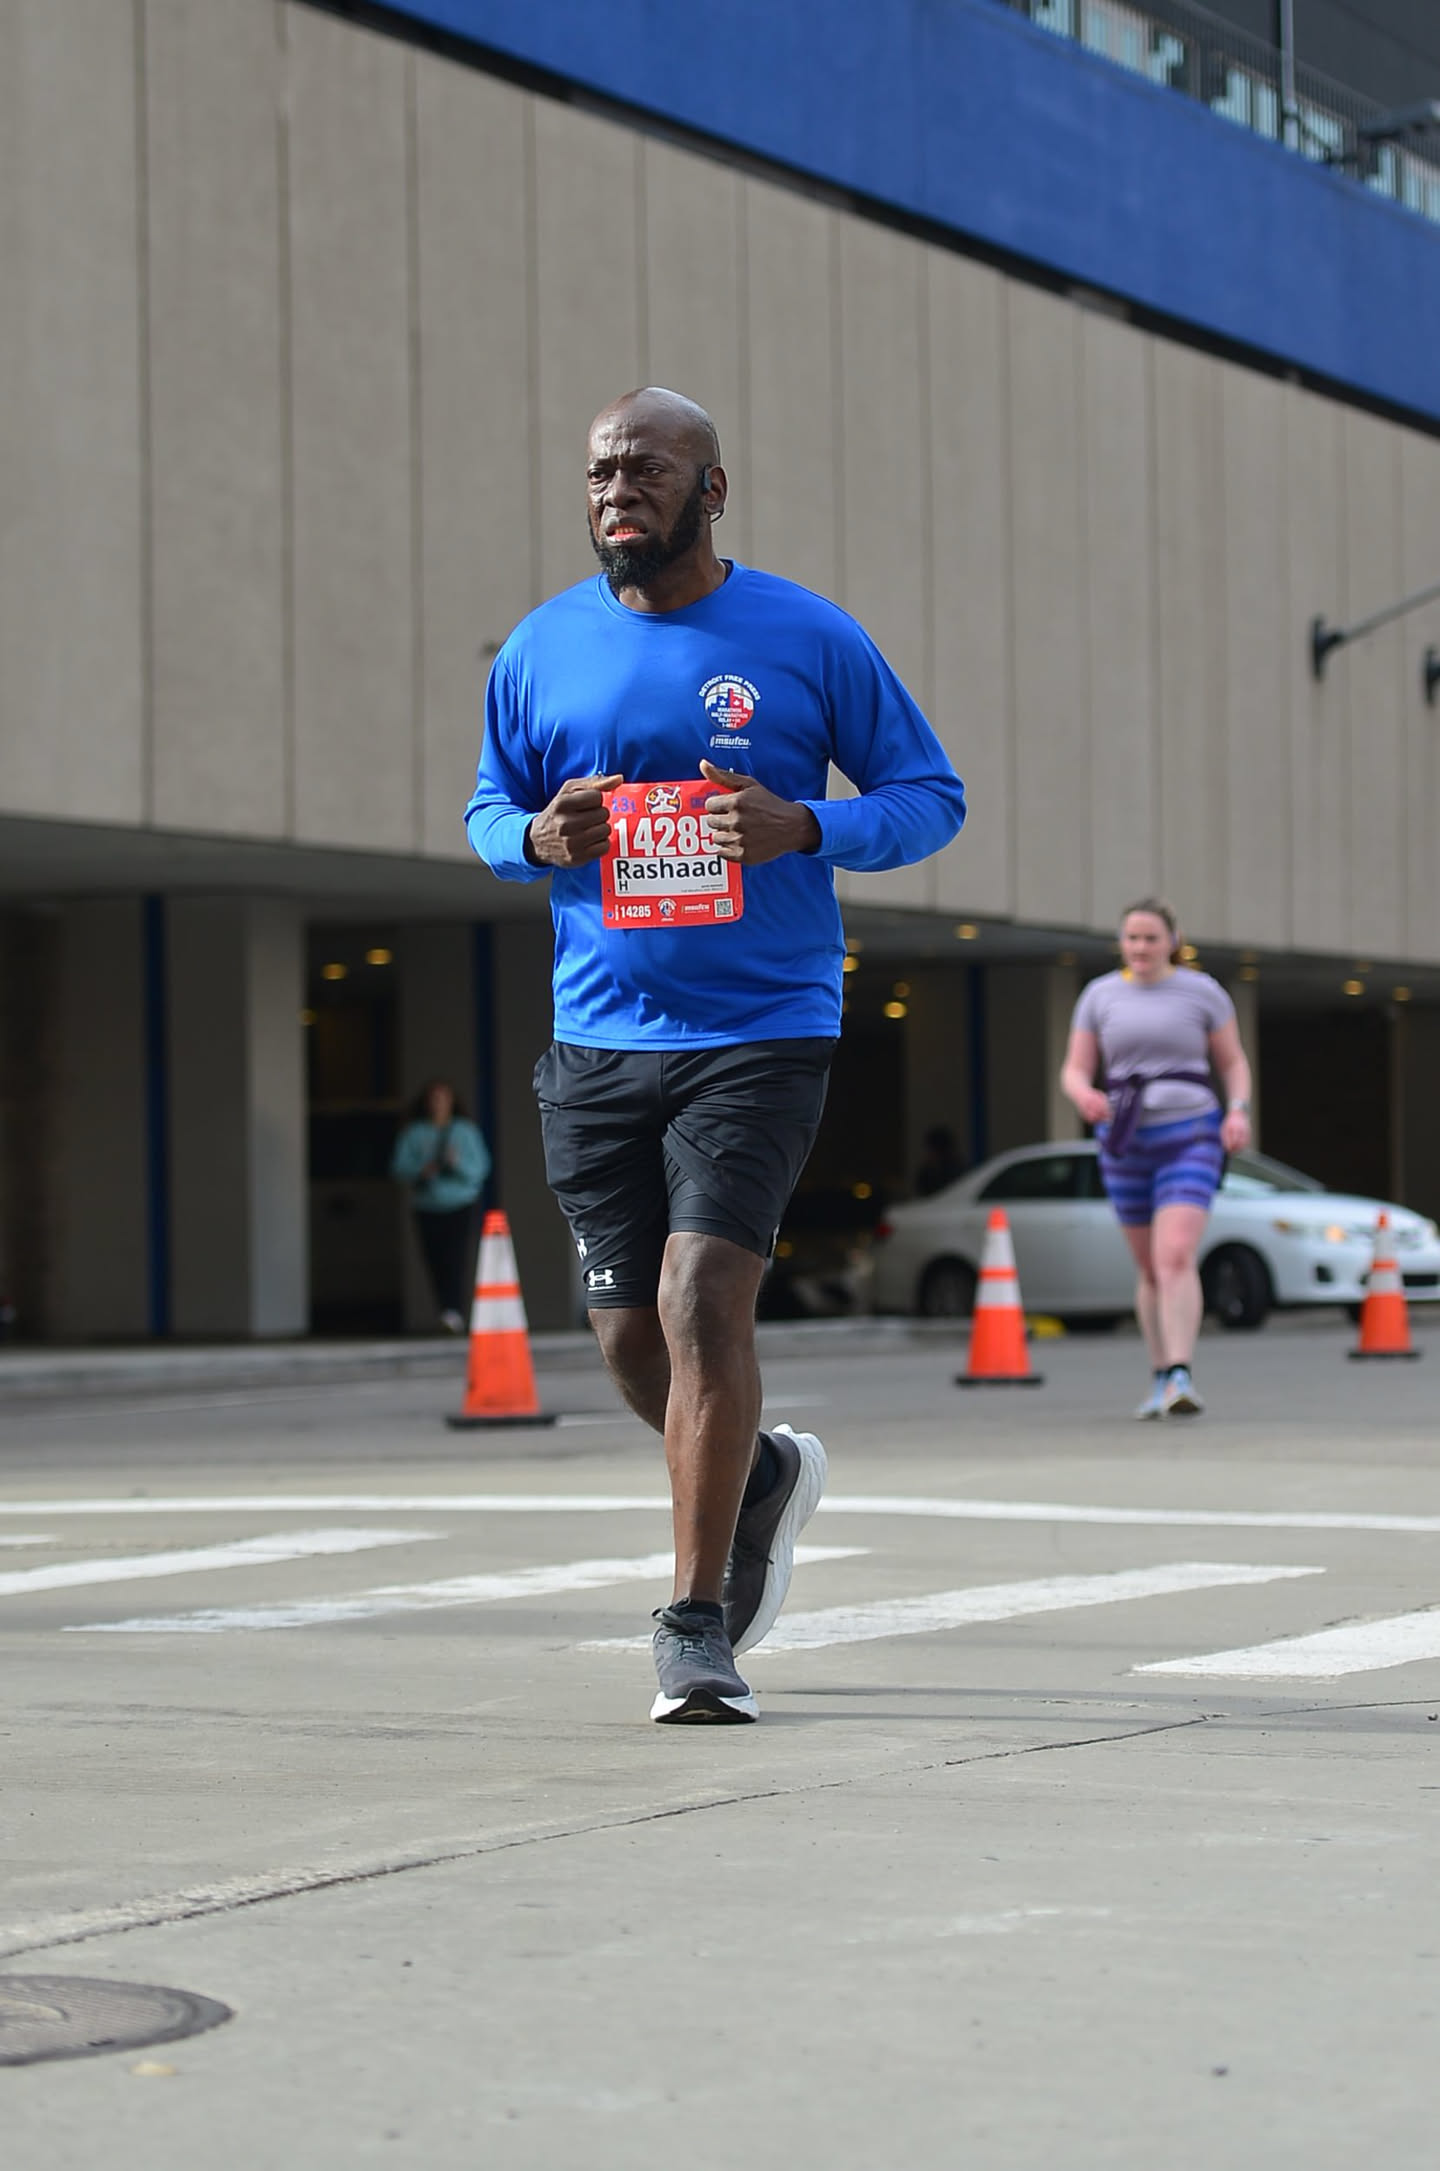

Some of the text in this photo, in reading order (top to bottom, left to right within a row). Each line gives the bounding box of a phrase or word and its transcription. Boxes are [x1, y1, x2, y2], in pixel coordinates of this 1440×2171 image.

[614, 815, 722, 857] 14285
[616, 855, 722, 880] Rashaad
[619, 880, 629, 892] H
[620, 905, 651, 918] 14285
